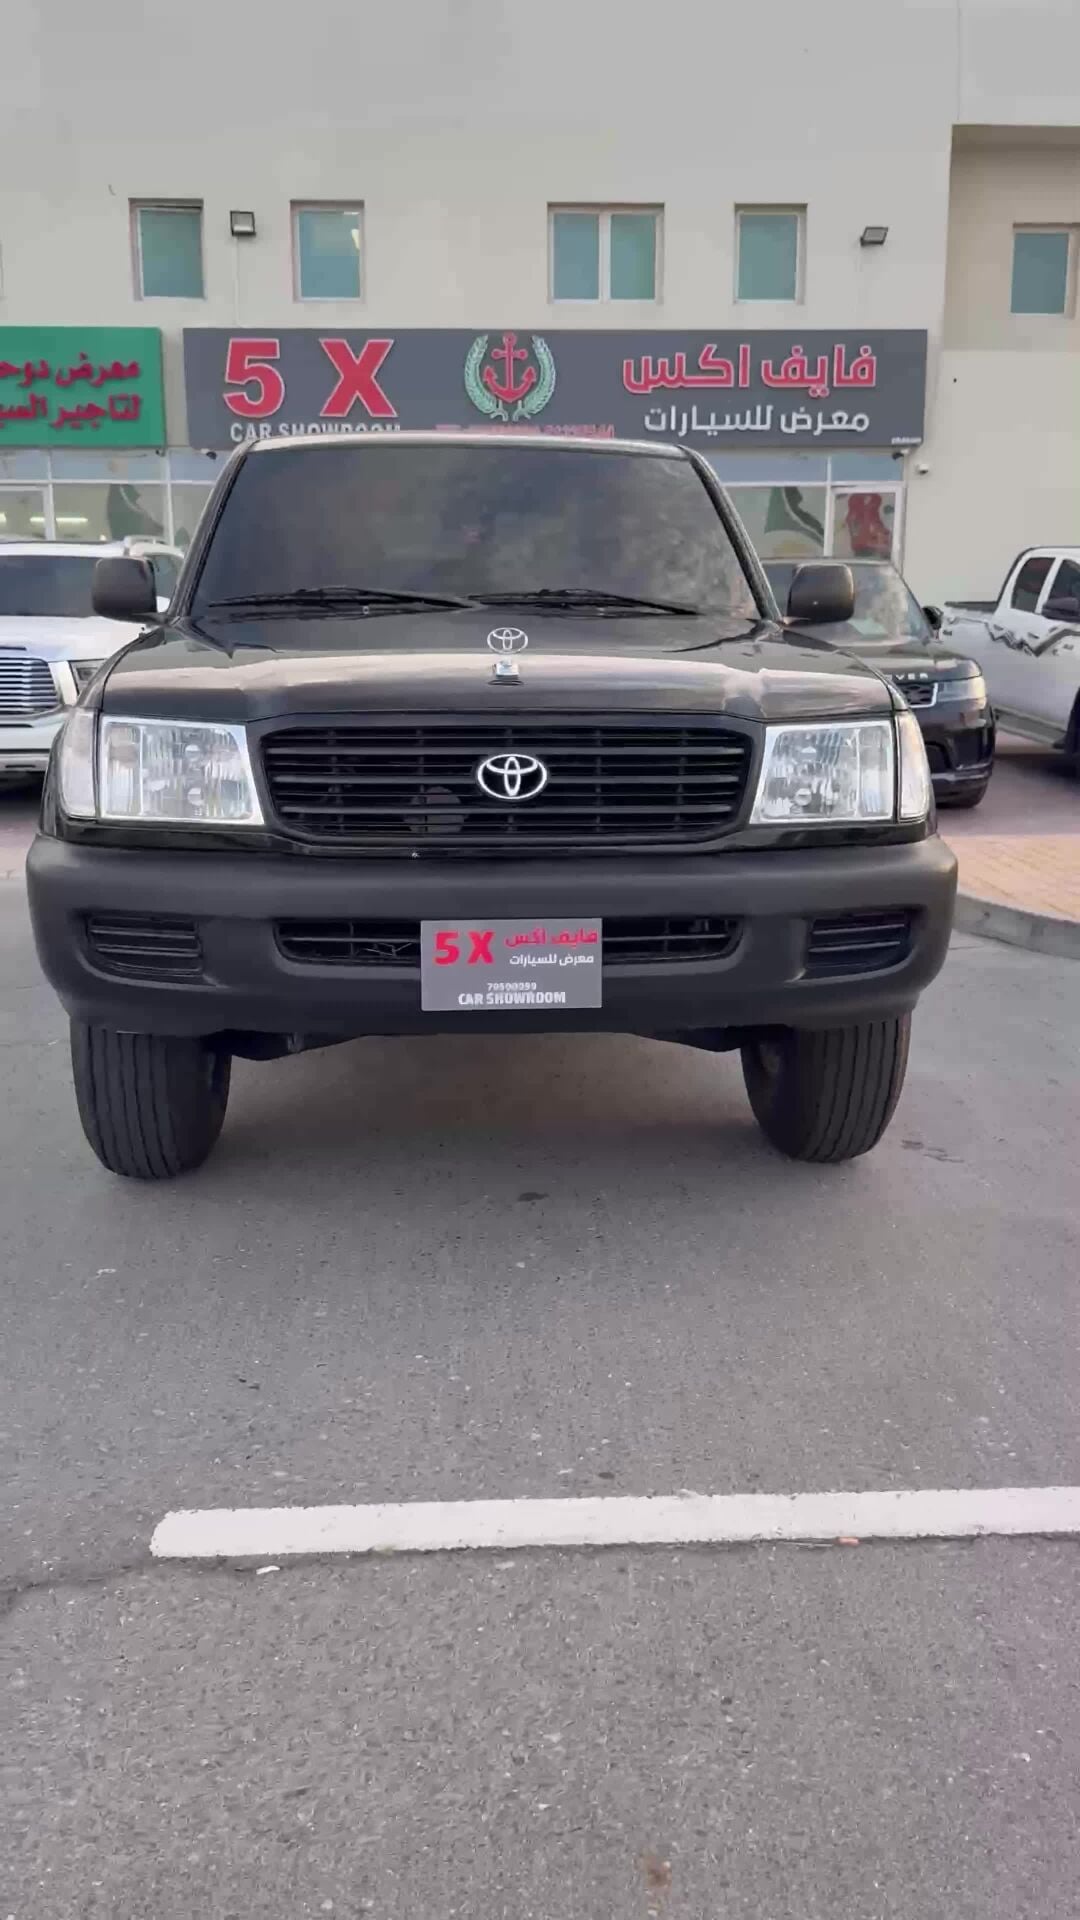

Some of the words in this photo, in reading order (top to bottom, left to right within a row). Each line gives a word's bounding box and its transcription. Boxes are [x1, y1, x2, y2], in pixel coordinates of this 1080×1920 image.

[55, 351, 140, 387] معرض
[223, 338, 285, 418] 5
[319, 338, 398, 418] X
[622, 344, 750, 394] اكس
[761, 345, 877, 397] فايف
[230, 422, 272, 442] CAR
[644, 405, 774, 437] للسيارات
[780, 406, 870, 437] معرض
[434, 930, 460, 966] 5
[467, 931, 495, 965] X
[551, 928, 599, 949] فايف
[509, 953, 557, 968] للسيارات
[559, 953, 595, 967] معرض
[458, 993, 484, 1005] CAR
[486, 991, 566, 1005] SHOWROOM
